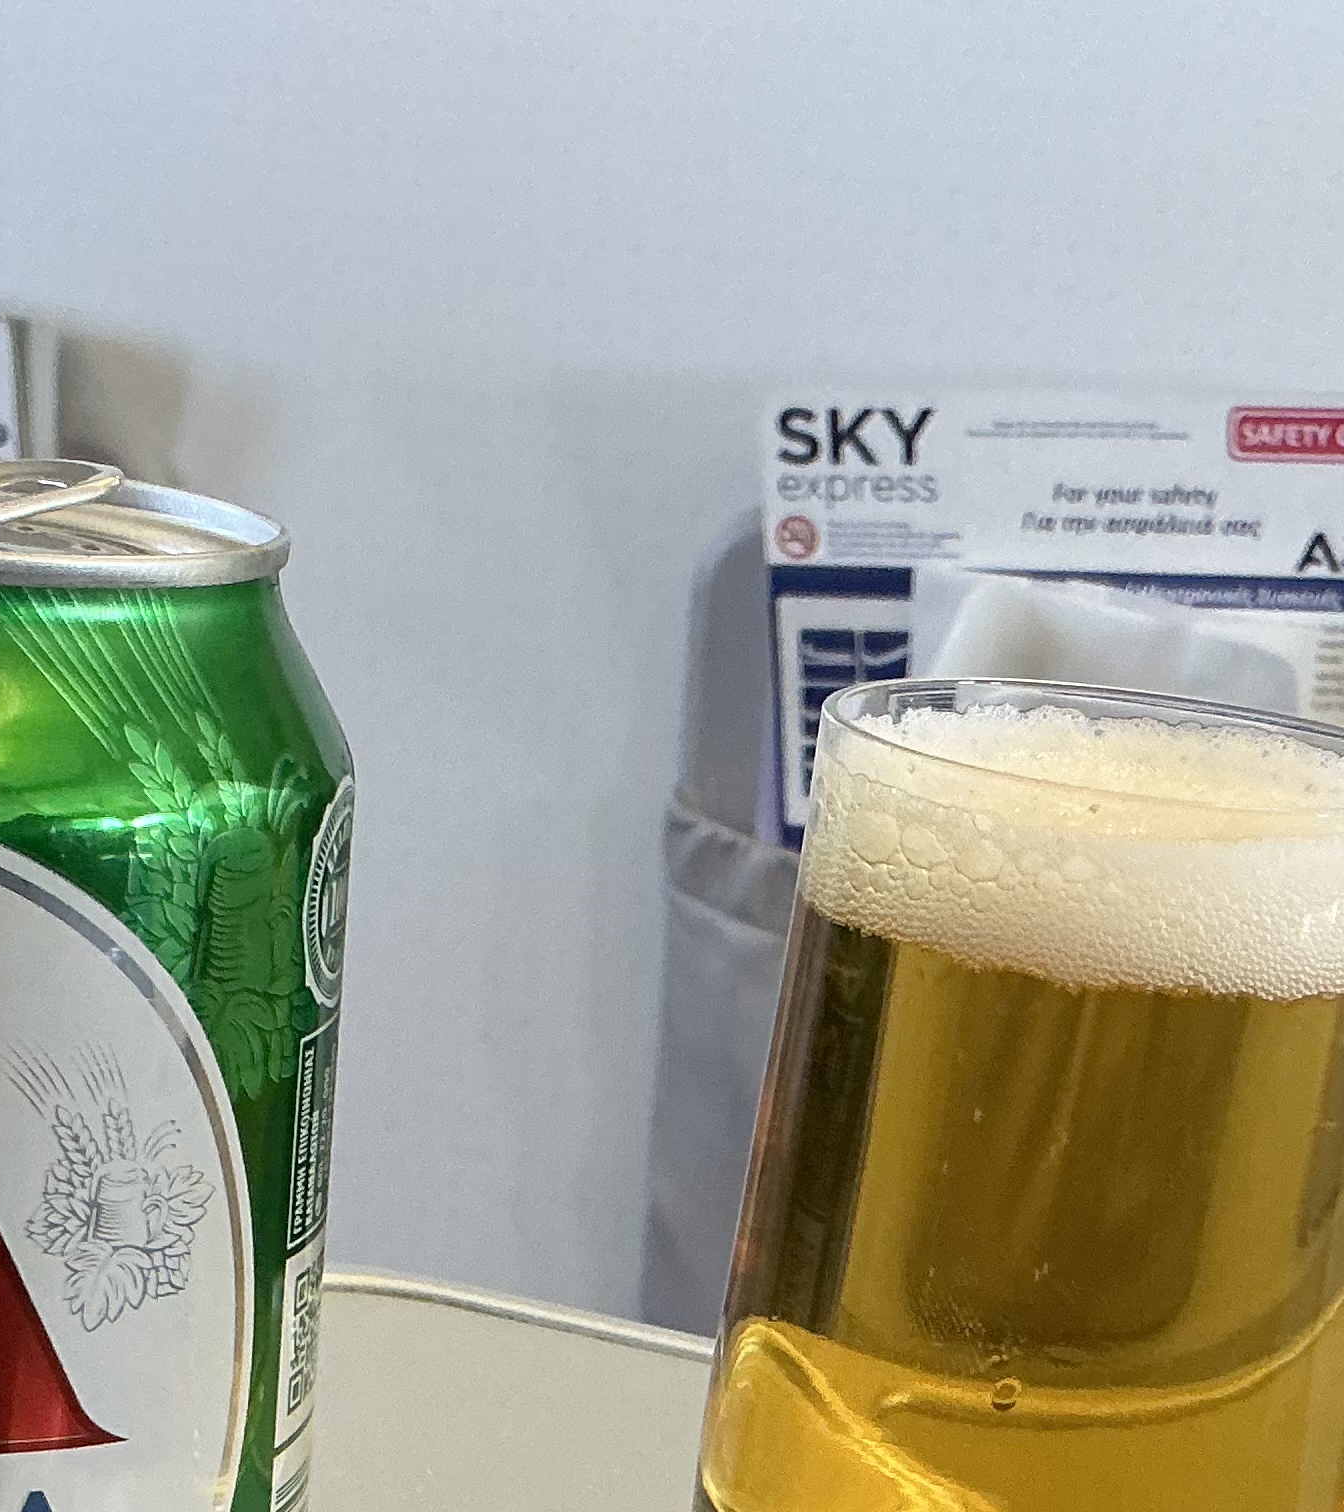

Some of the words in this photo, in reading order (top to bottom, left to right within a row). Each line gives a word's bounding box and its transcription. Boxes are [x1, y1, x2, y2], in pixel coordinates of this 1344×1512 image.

[776, 405, 938, 467] SKY
[1241, 421, 1333, 448] SAFETY
[775, 472, 940, 509] express
